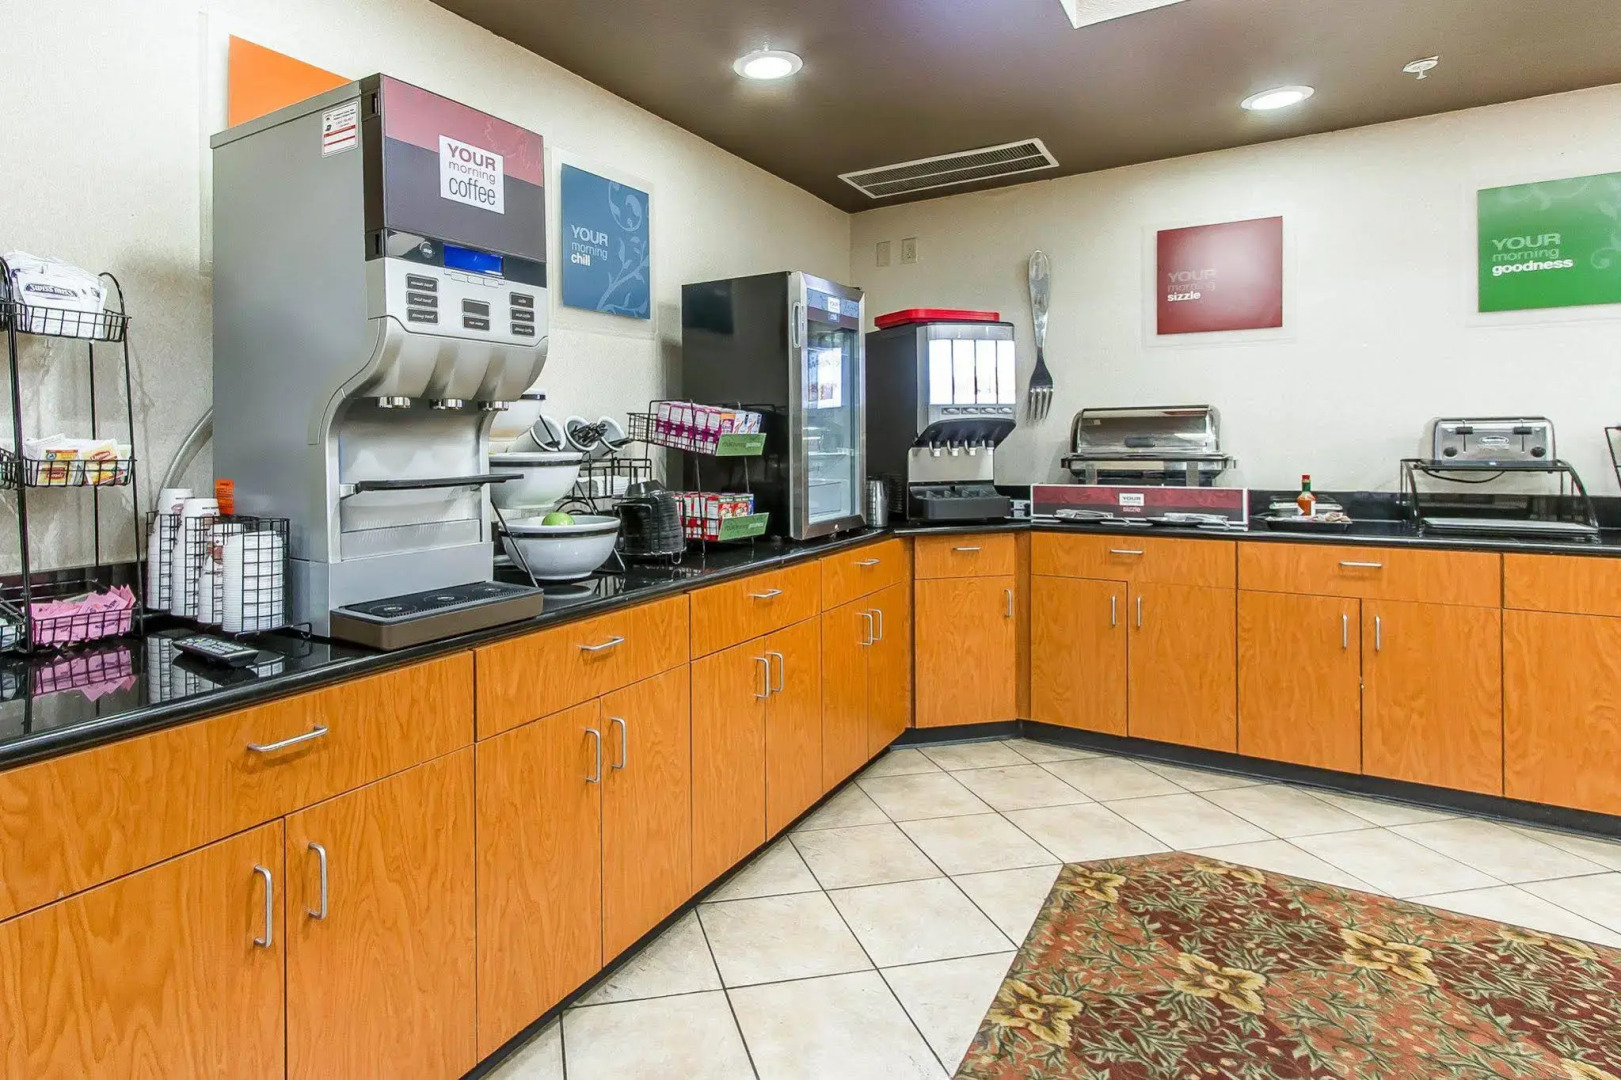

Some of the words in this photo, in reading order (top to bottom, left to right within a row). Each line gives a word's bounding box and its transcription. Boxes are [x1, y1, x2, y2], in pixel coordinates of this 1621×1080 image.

[447, 143, 496, 171] YOUR
[449, 161, 496, 185] morning
[449, 177, 496, 206] coffee
[571, 224, 608, 247] YOUR
[1492, 233, 1561, 251] YOUR
[571, 242, 608, 261] morning
[571, 252, 591, 267] chill
[1493, 248, 1560, 262] morning
[1167, 267, 1217, 283] YOUR
[1492, 259, 1574, 277] goodness
[1167, 290, 1201, 302] sizzle
